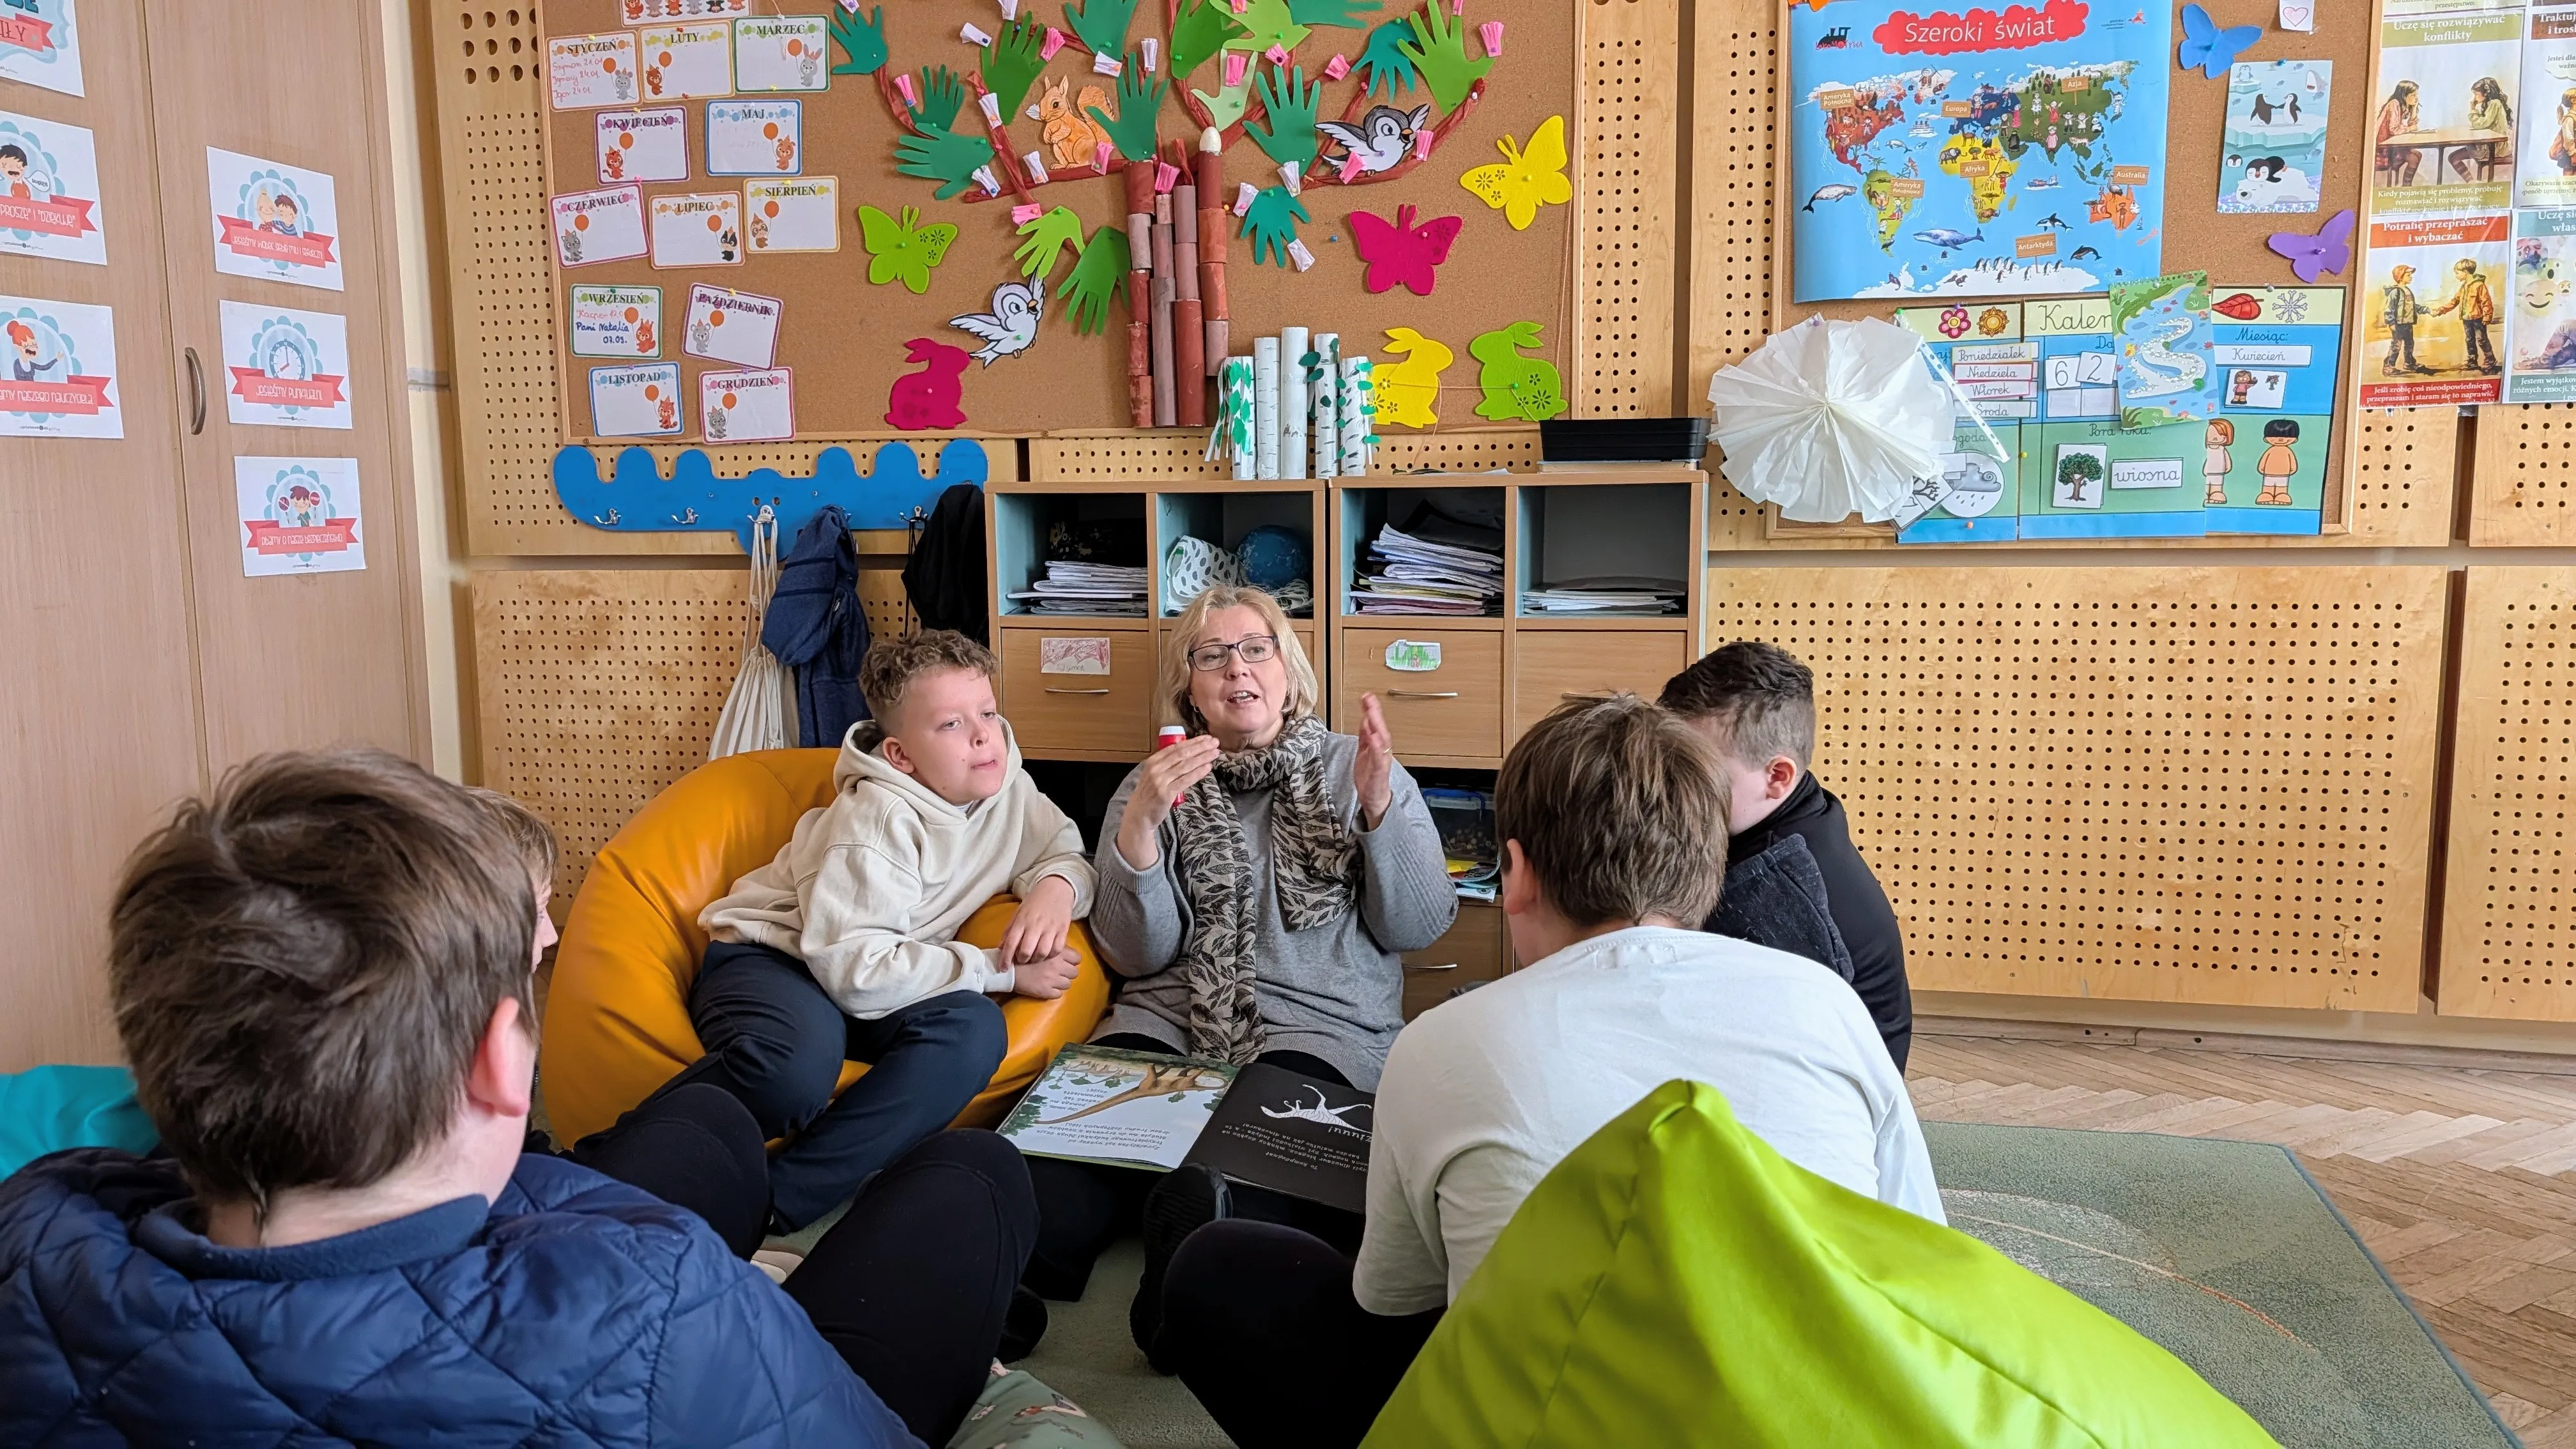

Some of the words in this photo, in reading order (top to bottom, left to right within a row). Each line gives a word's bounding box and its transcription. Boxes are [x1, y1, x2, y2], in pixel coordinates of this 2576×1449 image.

[2393, 20, 2418, 31] Uczę
[2420, 20, 2435, 29] się
[2437, 13, 2506, 29] rozwiązywać
[756, 24, 805, 35] MARZEC
[1905, 22, 1982, 43] Szeroki
[1995, 16, 2055, 40] świat
[2547, 26, 2552, 34] i
[671, 33, 700, 45] LUTY
[2423, 31, 2472, 42] konflikty
[567, 40, 617, 54] STYCZEŃ
[2067, 80, 2082, 89] Azja
[1823, 92, 1851, 101] Ameryka
[742, 109, 765, 119] MAJ
[613, 114, 668, 128] KWIECIEŃ
[765, 184, 817, 197] SIERPIEŃ
[2399, 190, 2426, 198] pojawią
[2439, 187, 2473, 197] problemy,
[2474, 185, 2503, 195] próbuję
[567, 194, 625, 213] CZERWIEC
[677, 201, 713, 213] LIPIEC
[2396, 197, 2433, 206] rozmawiać
[2538, 211, 2564, 221] Uczę
[2566, 210, 2576, 219] si
[2384, 220, 2423, 232] Potrafię
[2426, 216, 2488, 230] przepraszać
[2408, 234, 2412, 243] i
[2414, 232, 2464, 245] wybaczać
[2018, 241, 2053, 251] Antarktyda
[588, 292, 644, 304] WRZESIEŃ
[698, 293, 772, 316] PAŹDZIERNIK
[576, 321, 596, 332] Pani
[599, 321, 630, 332] Natalia
[2235, 327, 2288, 344] Miesiąc:
[1958, 347, 2026, 362] Poniedziałek
[2232, 348, 2286, 362] Kwiecień
[1966, 366, 2018, 378] Niedziela
[2055, 361, 2069, 386] 6
[2087, 355, 2103, 381] 2
[608, 372, 661, 385] LISTOPAD
[717, 374, 775, 390] GRUDZIEŃ
[1970, 382, 2011, 396] Wtorek
[2374, 386, 2388, 395] Jeśli
[2389, 385, 2411, 394] zrobię
[2426, 383, 2492, 392] nieodpowiedniego,
[2513, 386, 2542, 394] różnych
[2366, 395, 2410, 404] przepraszam
[1976, 402, 2009, 417] Środa
[2089, 423, 2115, 436] Pora
[2113, 467, 2181, 482] wiosna
